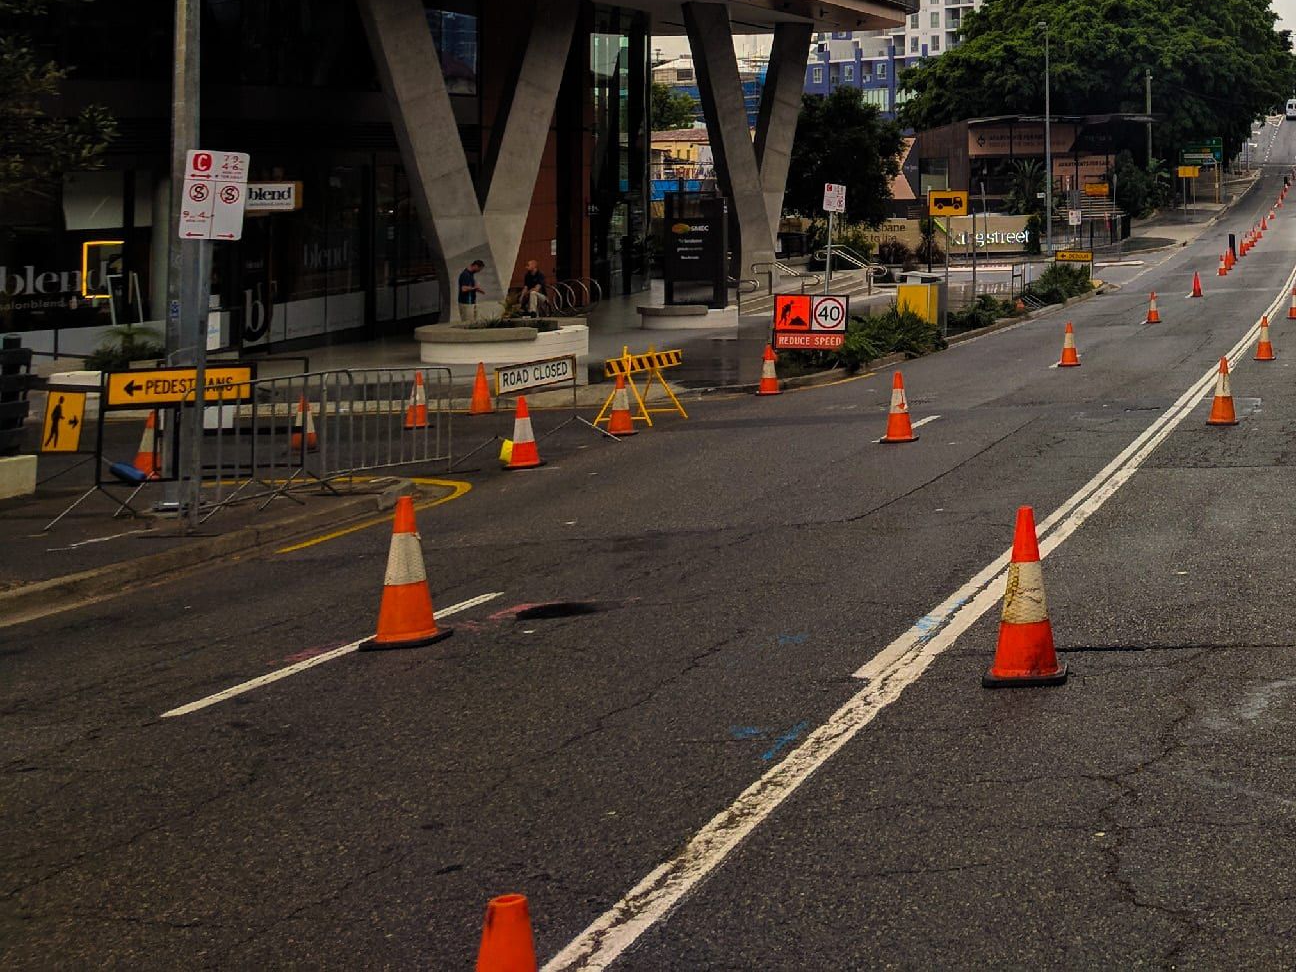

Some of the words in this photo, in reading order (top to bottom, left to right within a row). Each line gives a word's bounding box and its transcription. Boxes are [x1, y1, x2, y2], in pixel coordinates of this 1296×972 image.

[248, 187, 292, 201] blend
[0, 260, 108, 297] blend
[817, 305, 841, 321] 40
[778, 336, 811, 346] REDUCE
[814, 336, 842, 346] SPEED
[502, 369, 530, 388] ROAD
[533, 361, 568, 381] CLOSED
